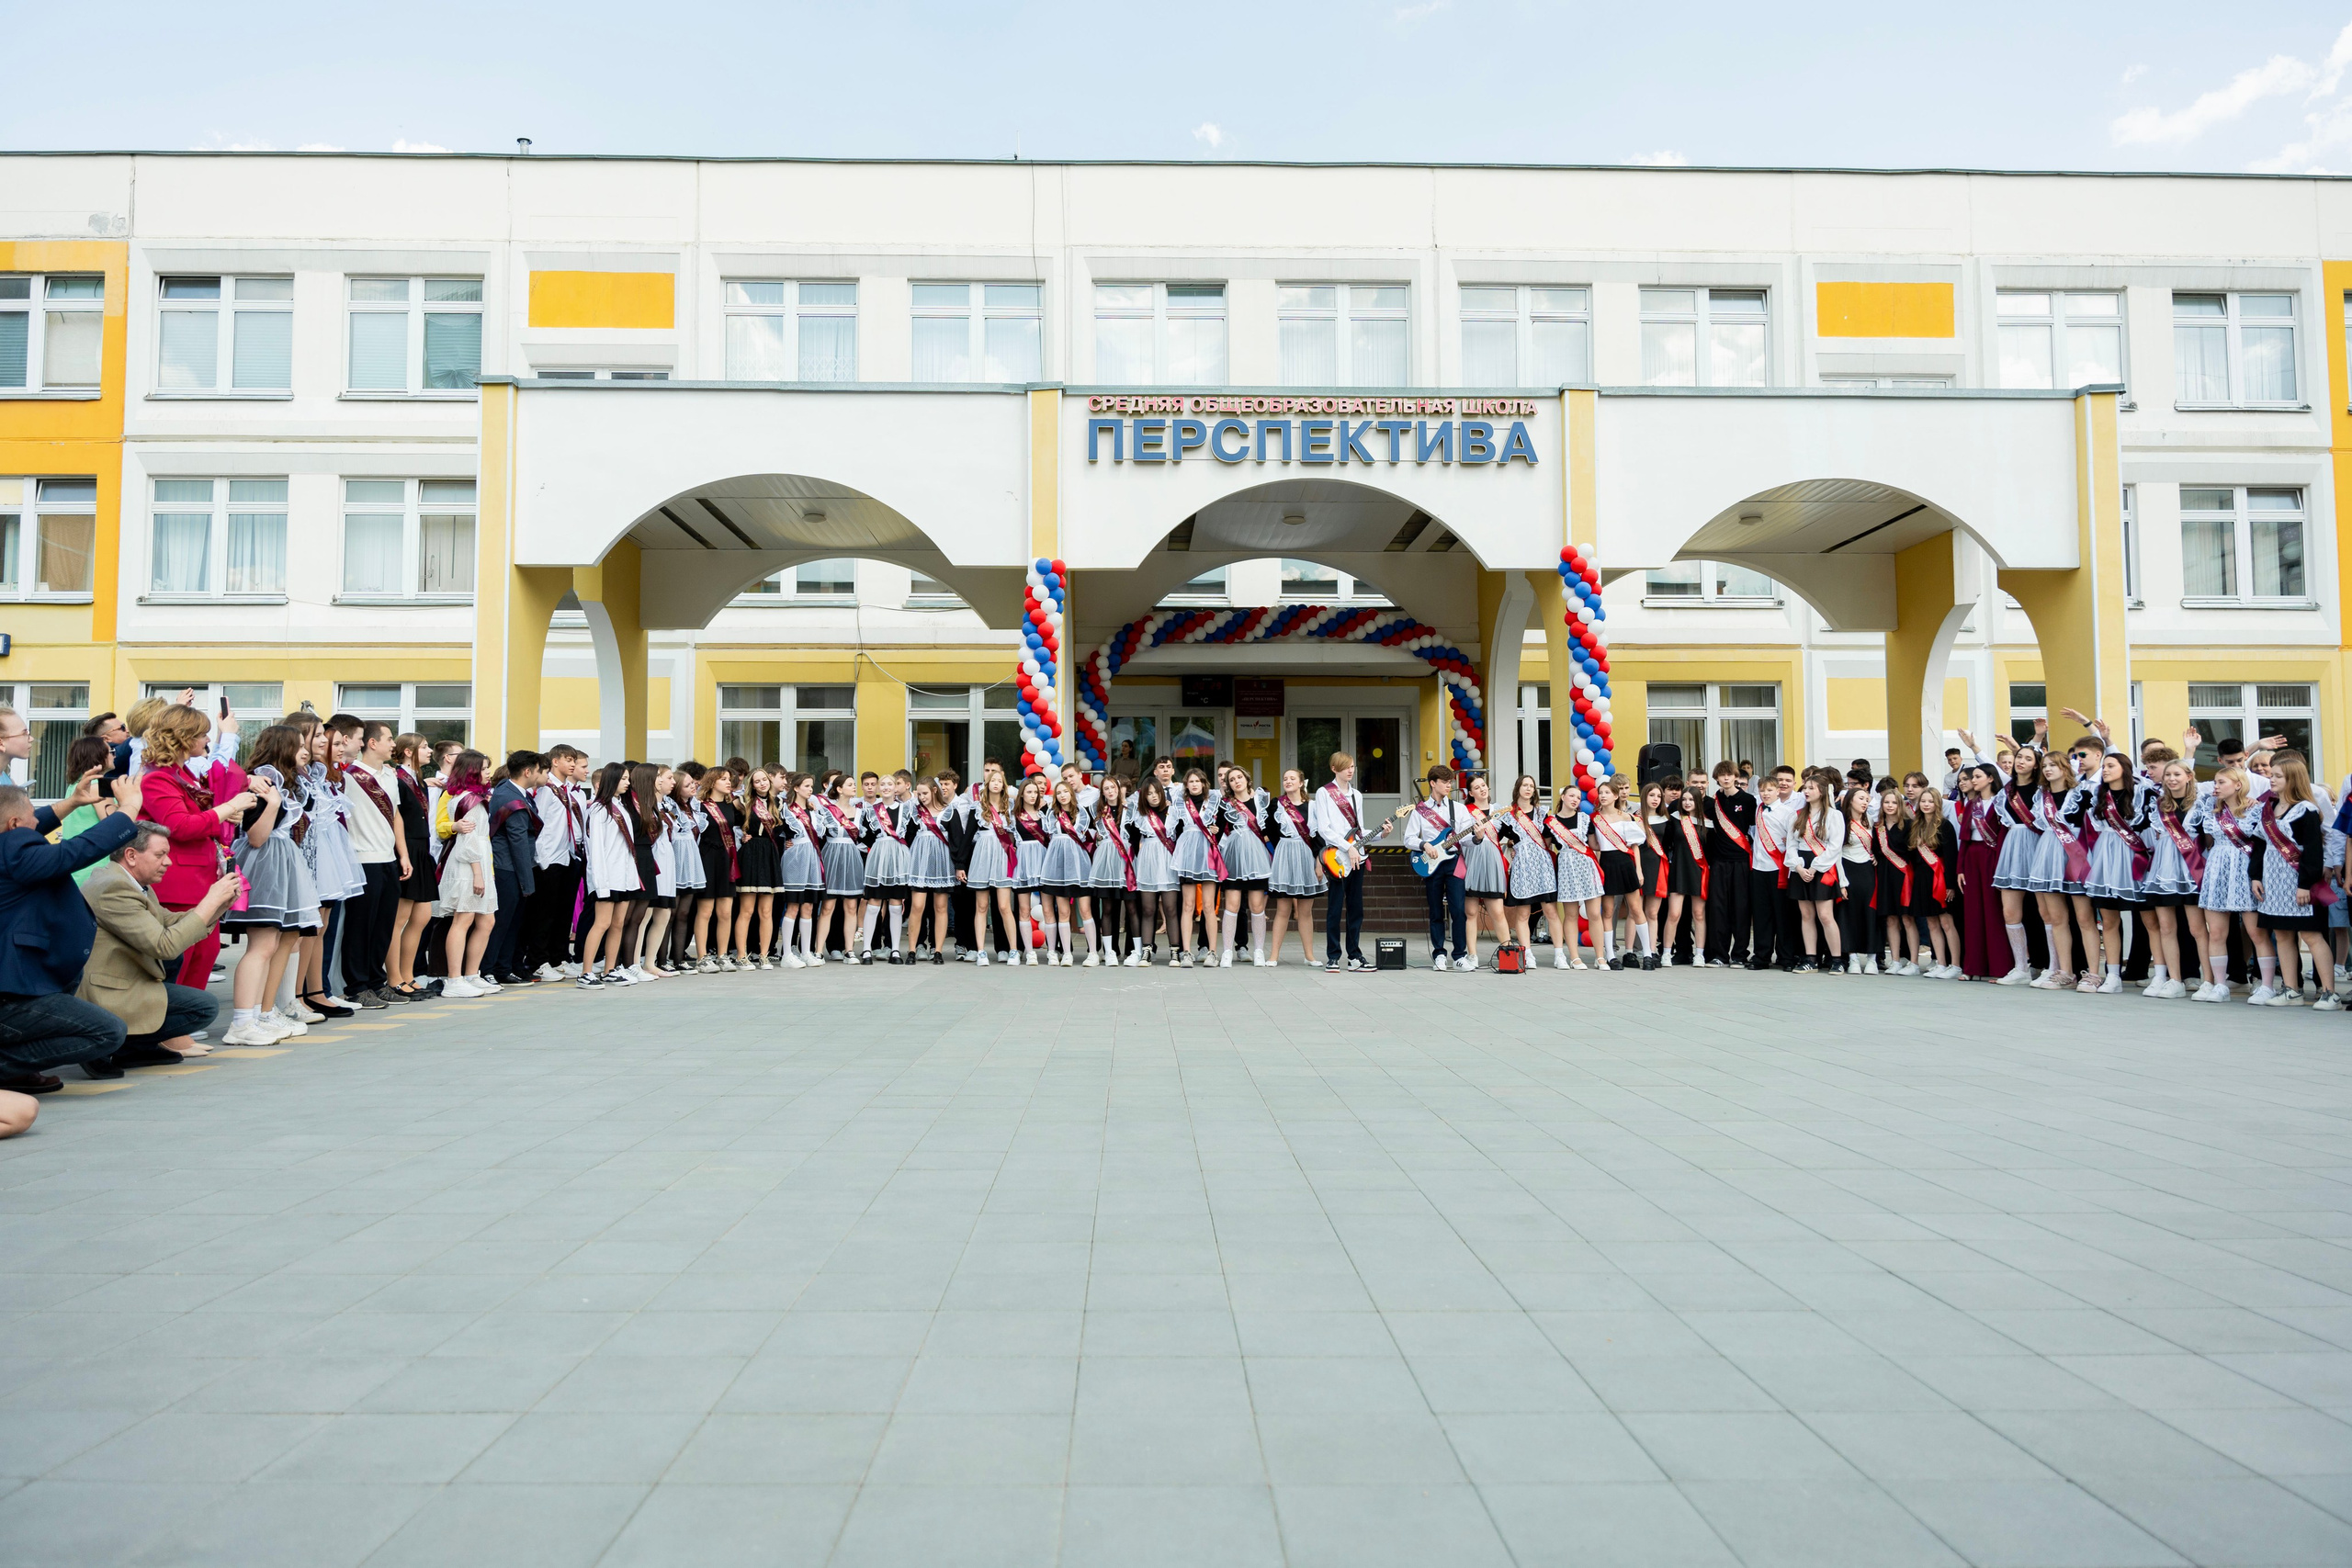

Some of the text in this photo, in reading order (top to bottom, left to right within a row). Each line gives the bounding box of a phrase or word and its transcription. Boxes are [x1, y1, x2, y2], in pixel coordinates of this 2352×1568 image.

[1088, 396, 1539, 416] СРЕДНЯЯ ОБЩЕОБРАЗОВАТЕЛЬНАЯ ШКОЛА
[1088, 419, 1540, 464] ПЕРСПЕКТИВА
